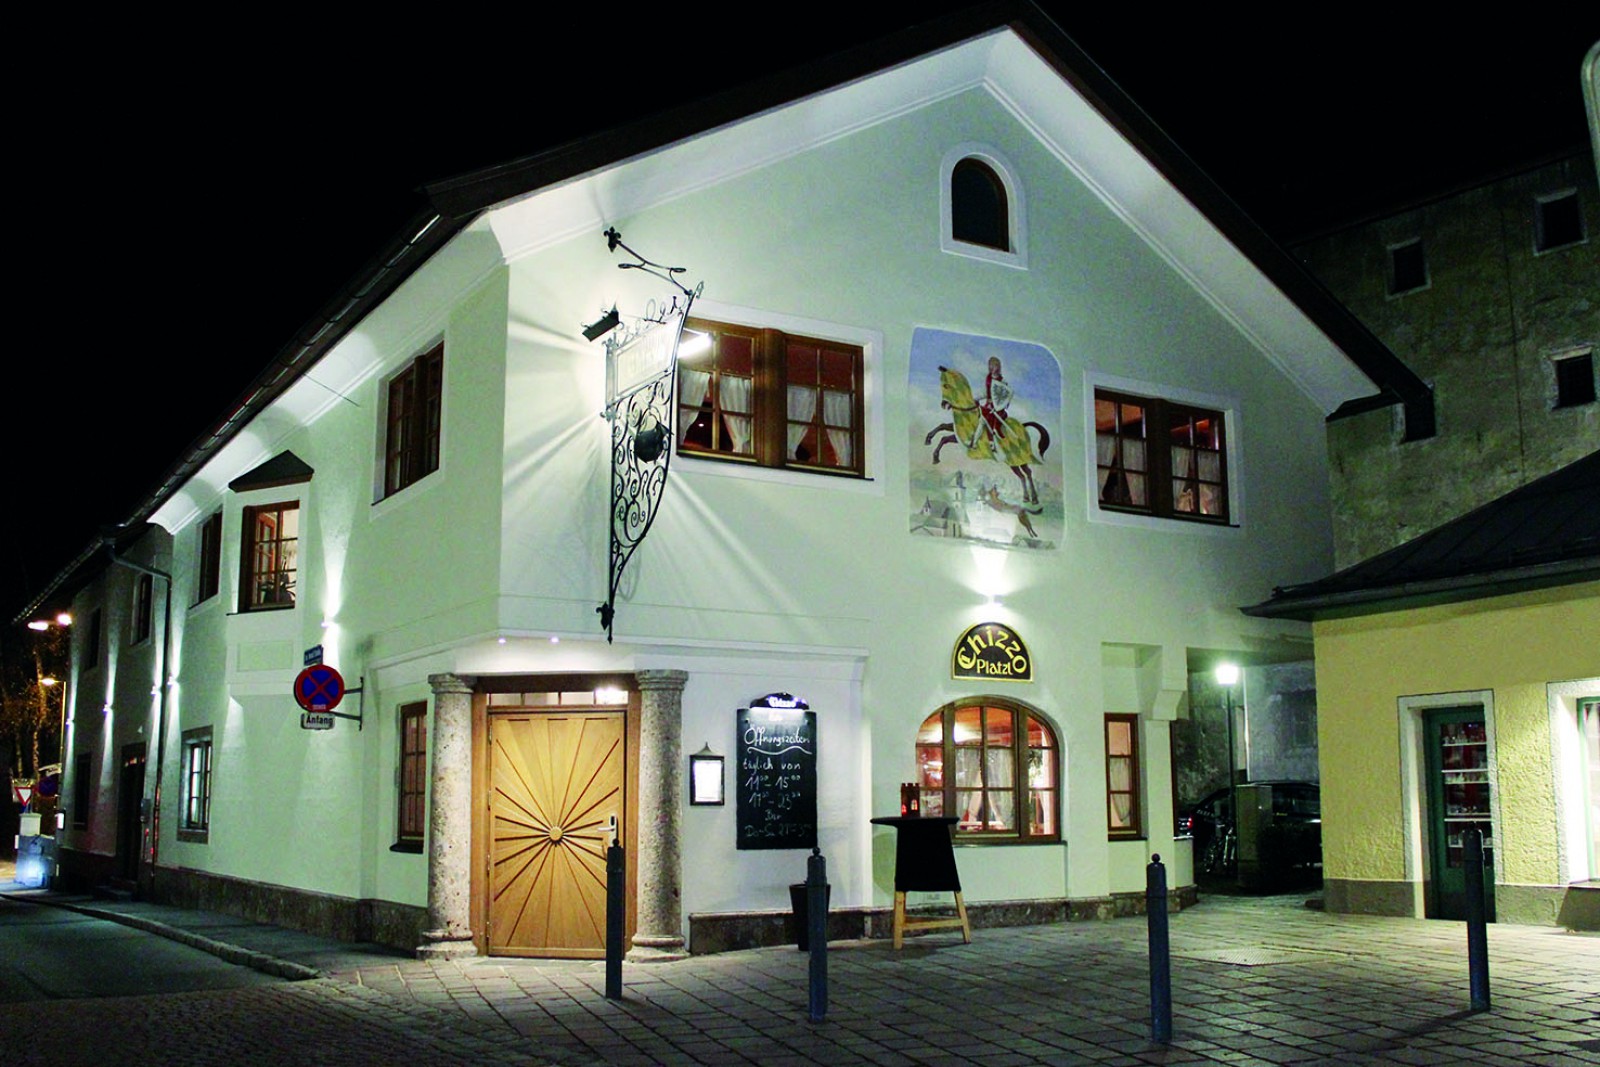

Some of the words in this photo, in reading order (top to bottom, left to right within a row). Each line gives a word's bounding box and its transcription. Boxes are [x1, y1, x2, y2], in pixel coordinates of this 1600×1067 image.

[957, 625, 1027, 674] Chizzo
[976, 658, 1014, 675] Platzl
[306, 714, 333, 725] Anfang
